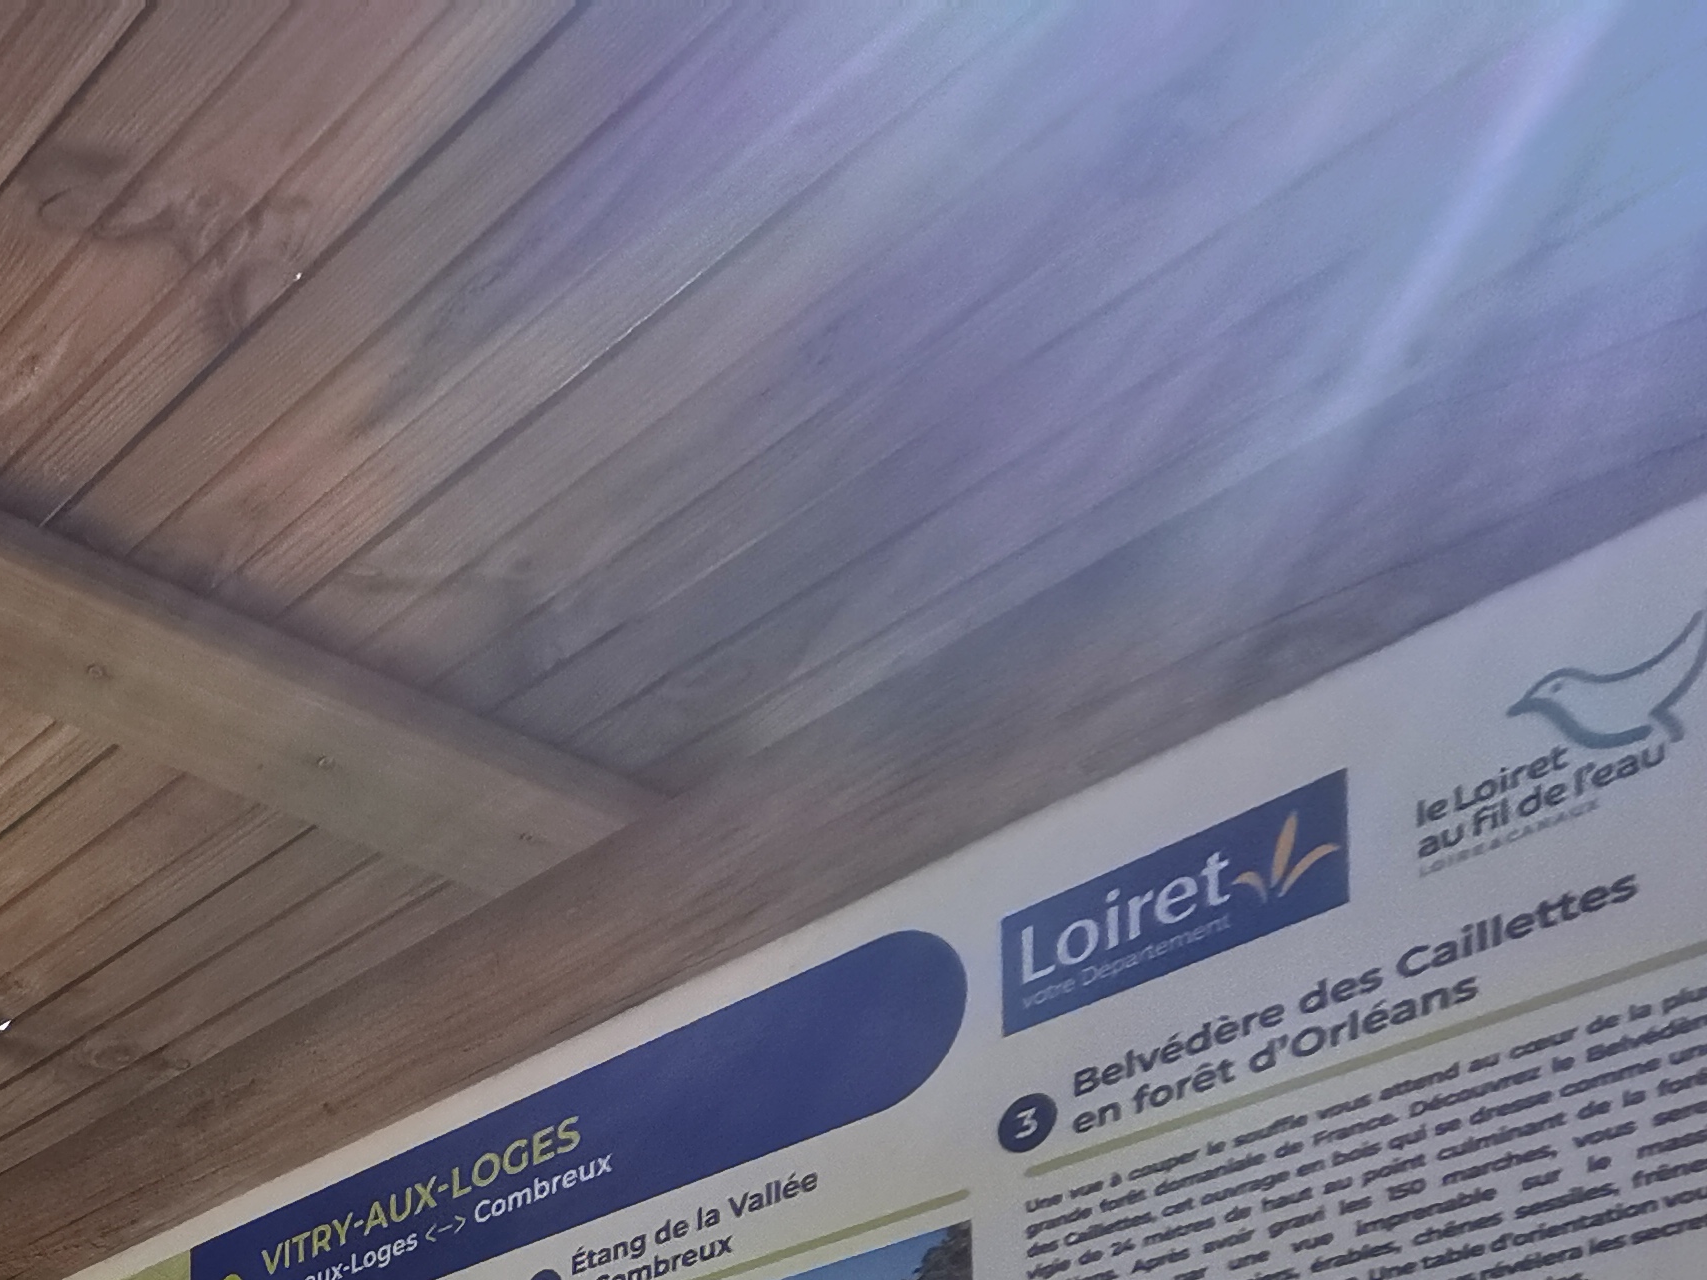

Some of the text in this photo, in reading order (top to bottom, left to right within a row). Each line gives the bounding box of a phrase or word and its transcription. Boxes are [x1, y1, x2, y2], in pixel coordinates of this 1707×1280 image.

[1416, 745, 1568, 828] le Loiret
[1418, 743, 1666, 858] au fil de l'eau
[1022, 851, 1231, 985] Loiret
[1073, 874, 1637, 1097] Belvédère des Caillettes
[1071, 976, 1479, 1134] en forêt d'Orléans
[1017, 1106, 1039, 1138] 3
[260, 1114, 582, 1277] VITRY-AUX-LOGES
[473, 1152, 614, 1225] Combreux
[571, 1172, 817, 1275] Étang de la Vallée
